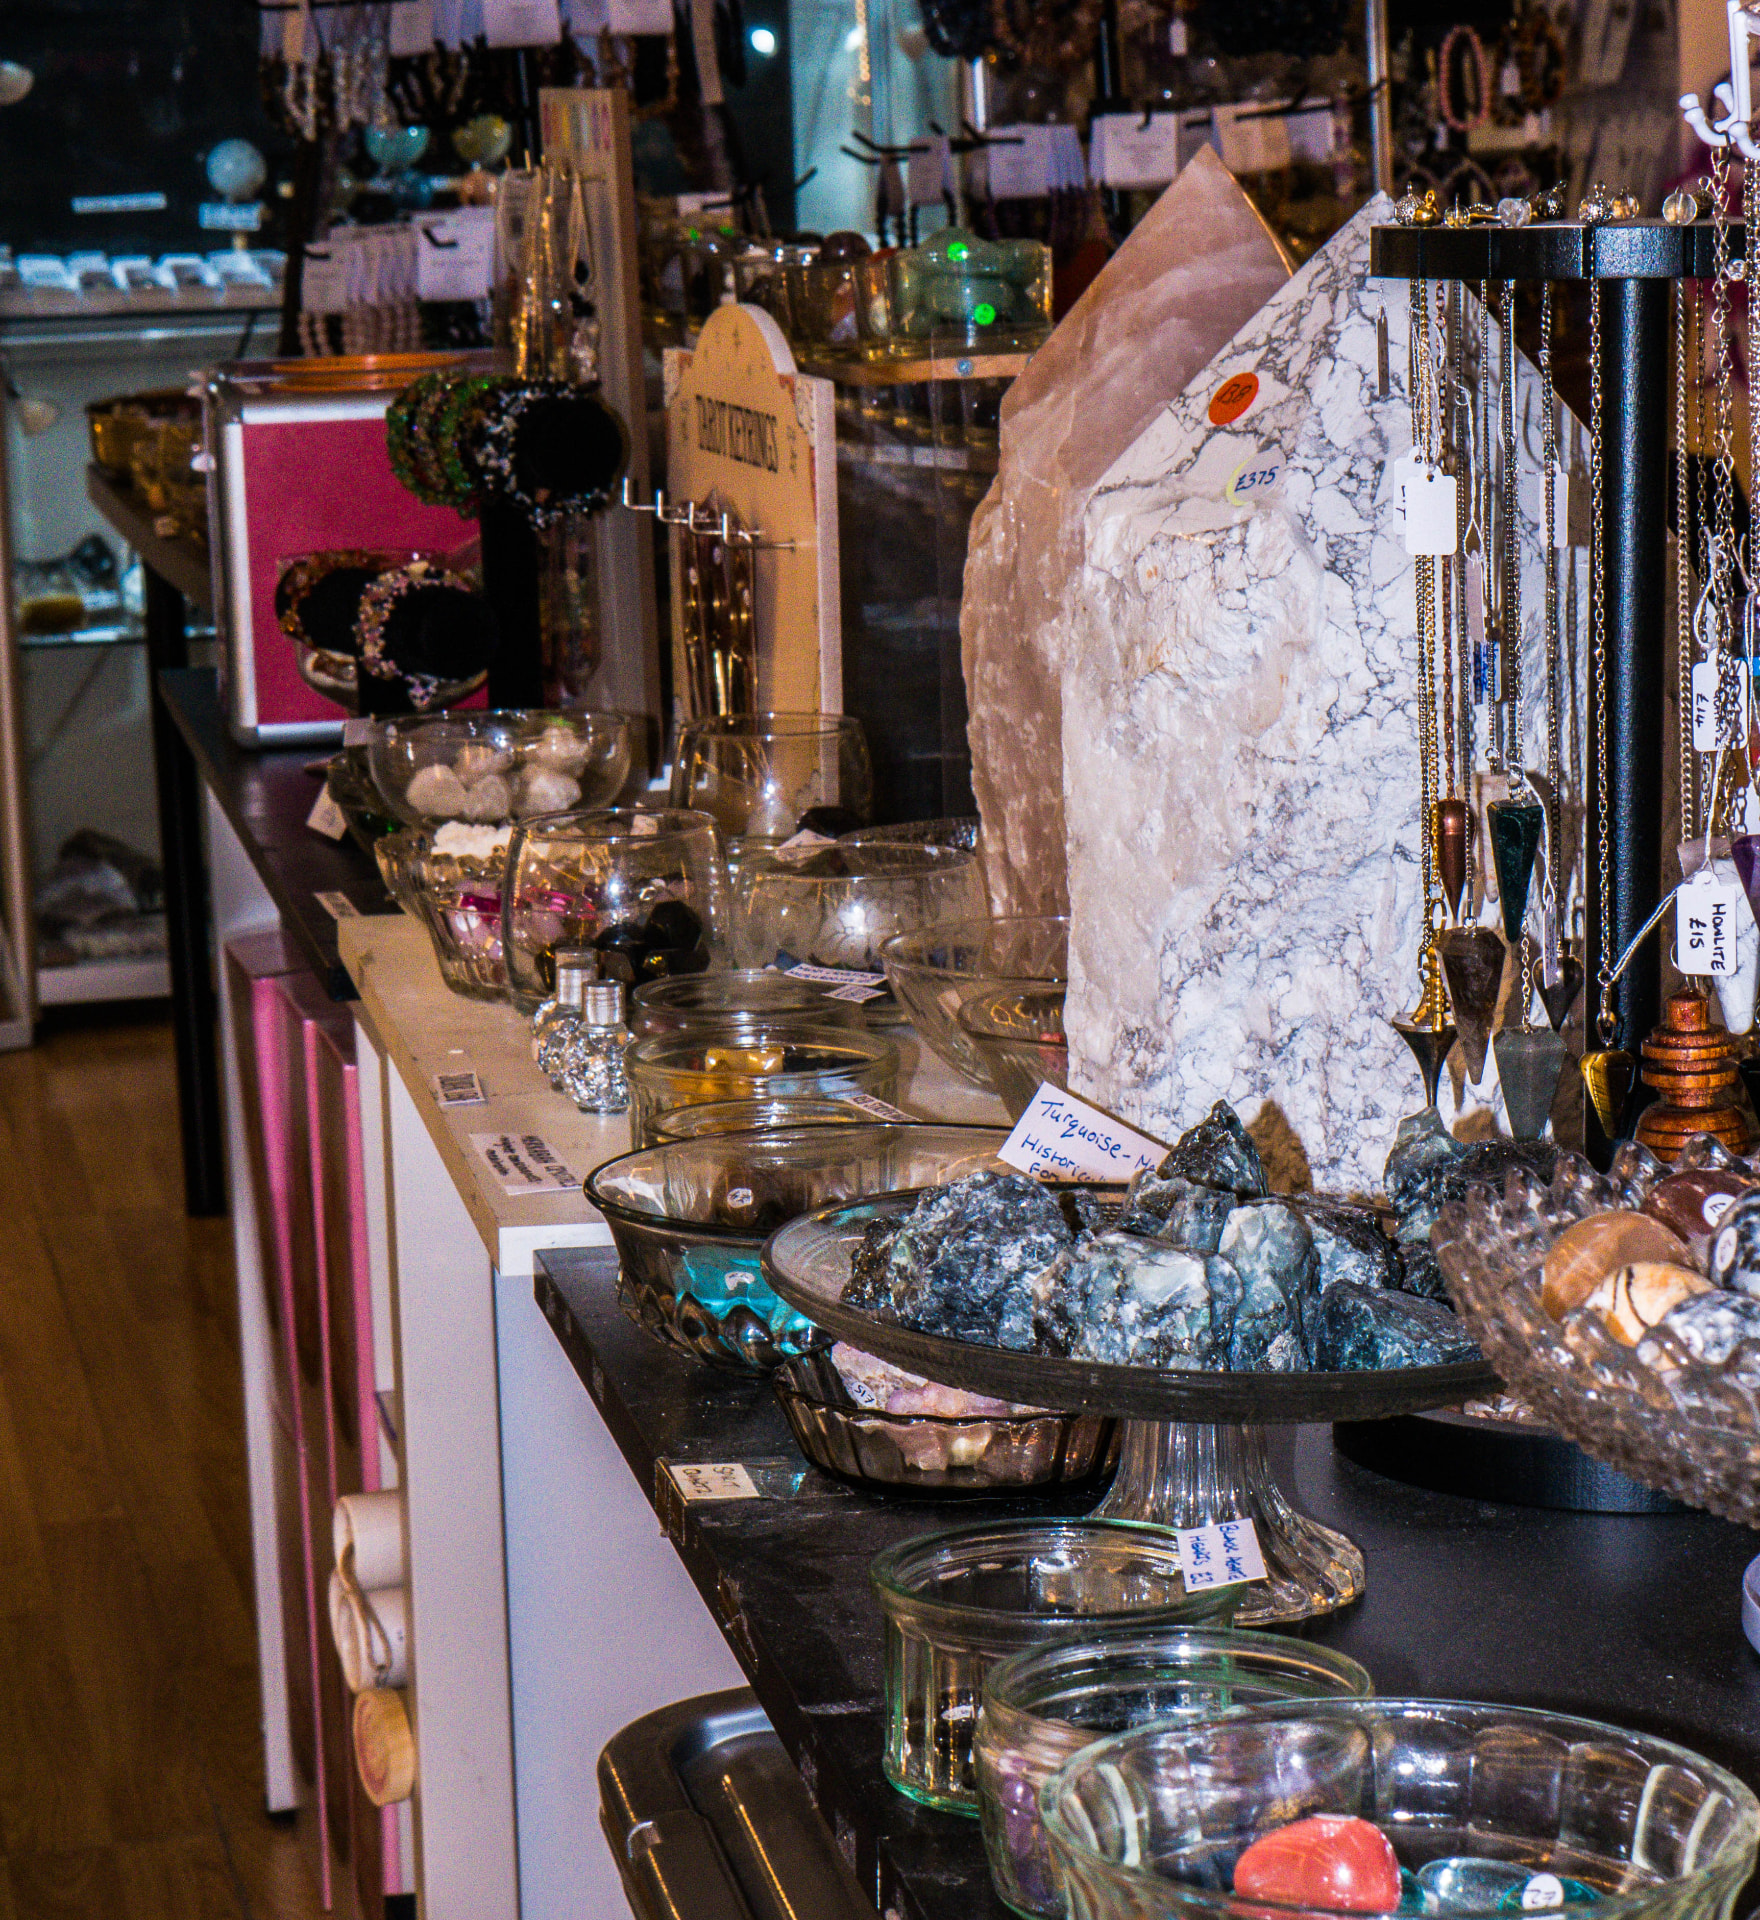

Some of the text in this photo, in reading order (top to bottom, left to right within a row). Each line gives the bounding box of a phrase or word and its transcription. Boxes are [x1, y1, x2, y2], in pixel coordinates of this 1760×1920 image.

[1234, 465, 1280, 492] £375
[1695, 693, 1709, 728] £14
[1689, 917, 1707, 949] £15
[1711, 903, 1727, 971] HOWLITE
[853, 1384, 875, 1404] £15
